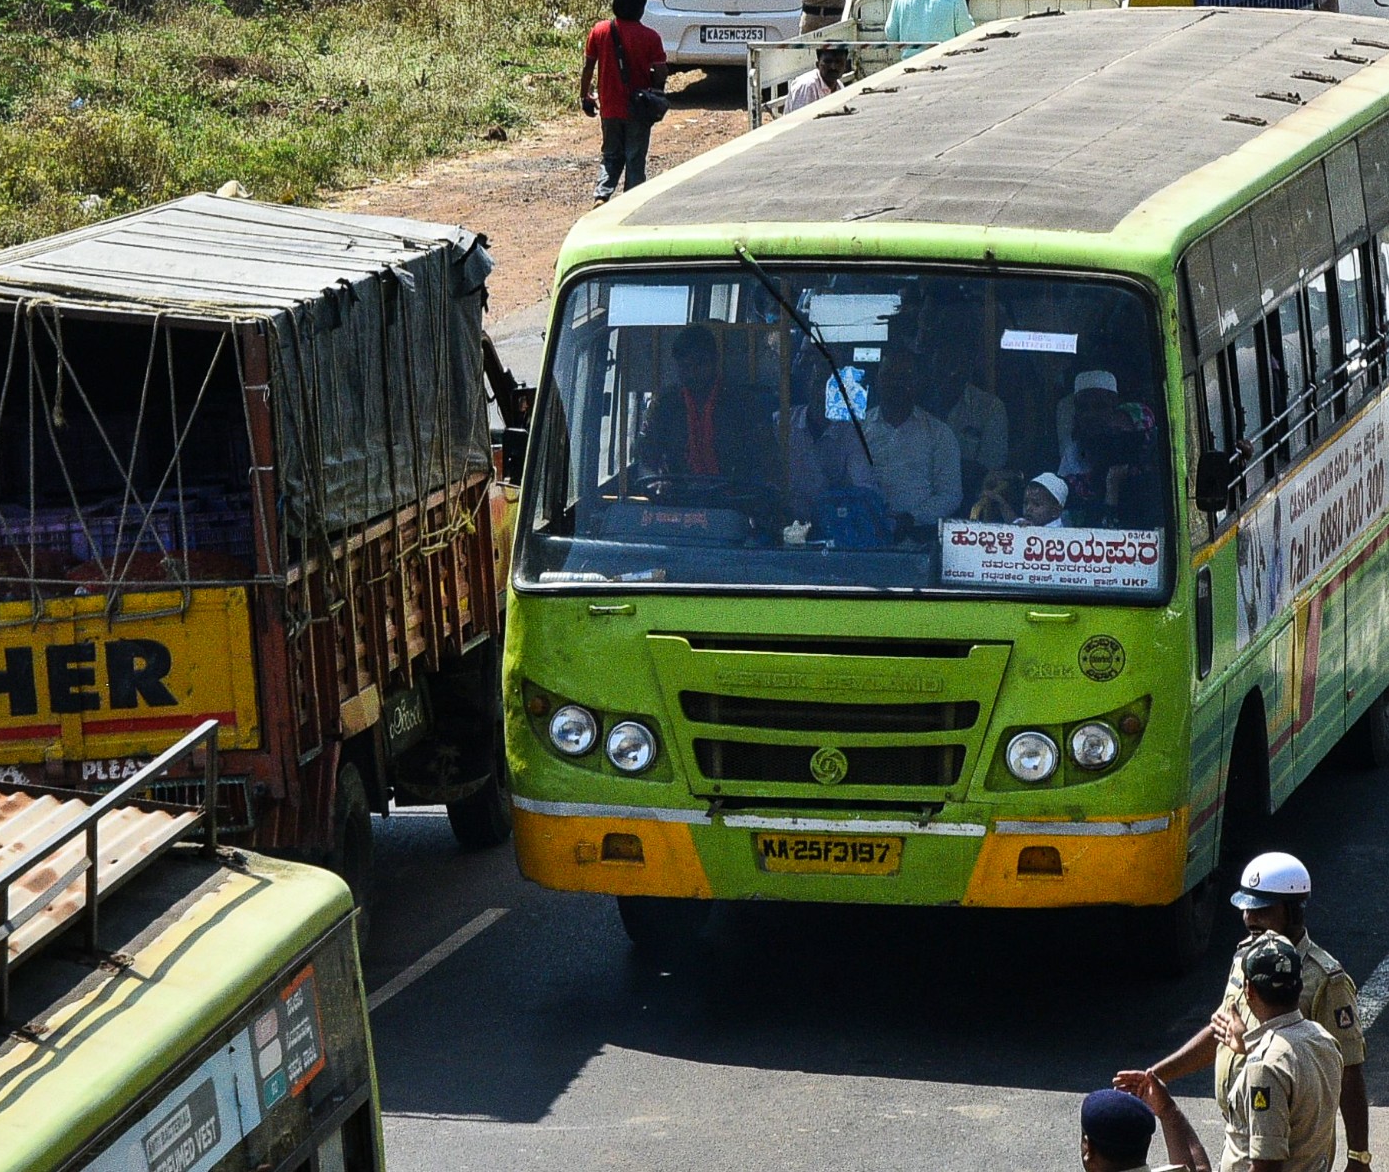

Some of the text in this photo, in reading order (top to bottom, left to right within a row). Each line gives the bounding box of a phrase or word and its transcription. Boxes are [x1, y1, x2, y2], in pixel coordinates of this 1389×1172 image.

[707, 27, 763, 41] KA25MC3253
[1290, 525, 1310, 590] Call
[1319, 496, 1344, 564] 8880
[1346, 479, 1364, 538] 300
[1366, 459, 1384, 518] 300
[1023, 531, 1158, 565] ವಿಜಯಪುರ
[1122, 578, 1149, 587] UKP
[763, 839, 891, 863] KA-25F3197
[195, 1115, 217, 1156] VEST
